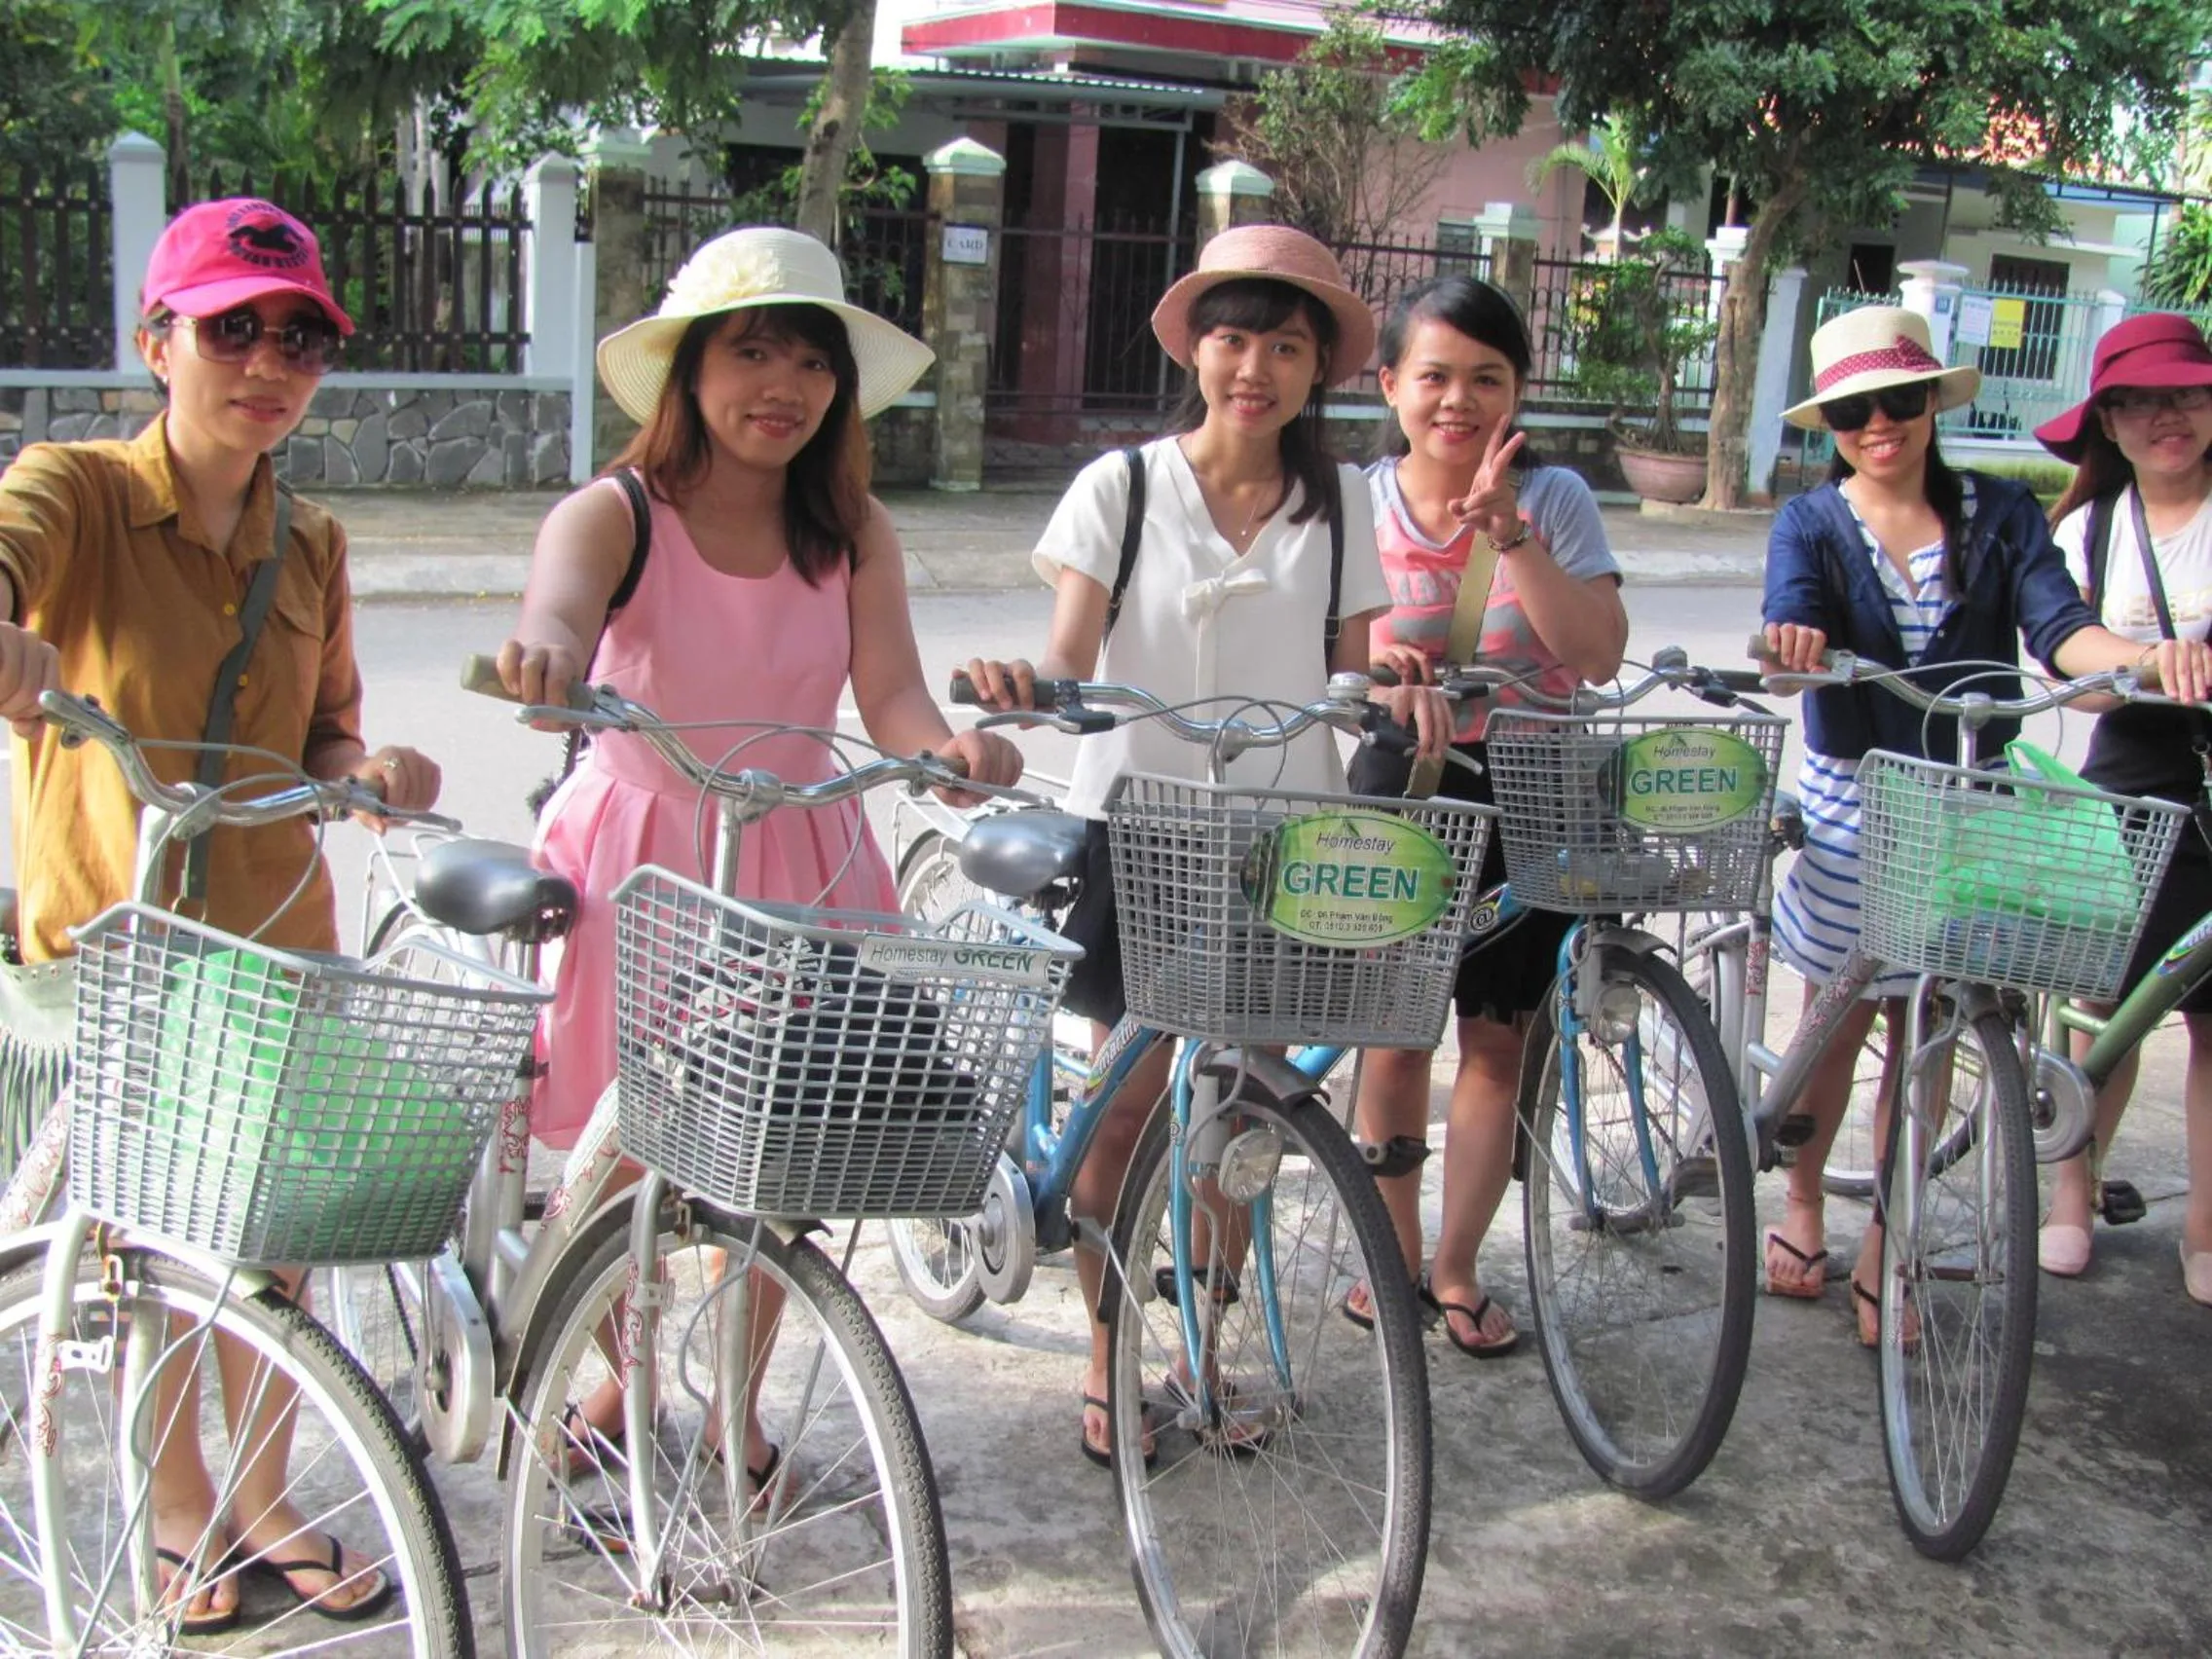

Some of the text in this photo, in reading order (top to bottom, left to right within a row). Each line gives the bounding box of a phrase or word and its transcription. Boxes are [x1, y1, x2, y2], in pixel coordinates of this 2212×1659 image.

[1654, 745, 1716, 759] Homestay
[1631, 766, 1738, 796] GREEN
[1315, 831, 1396, 856] Homestay
[1281, 860, 1420, 903] GREEN
[870, 944, 1036, 973] Homestay GREEN
